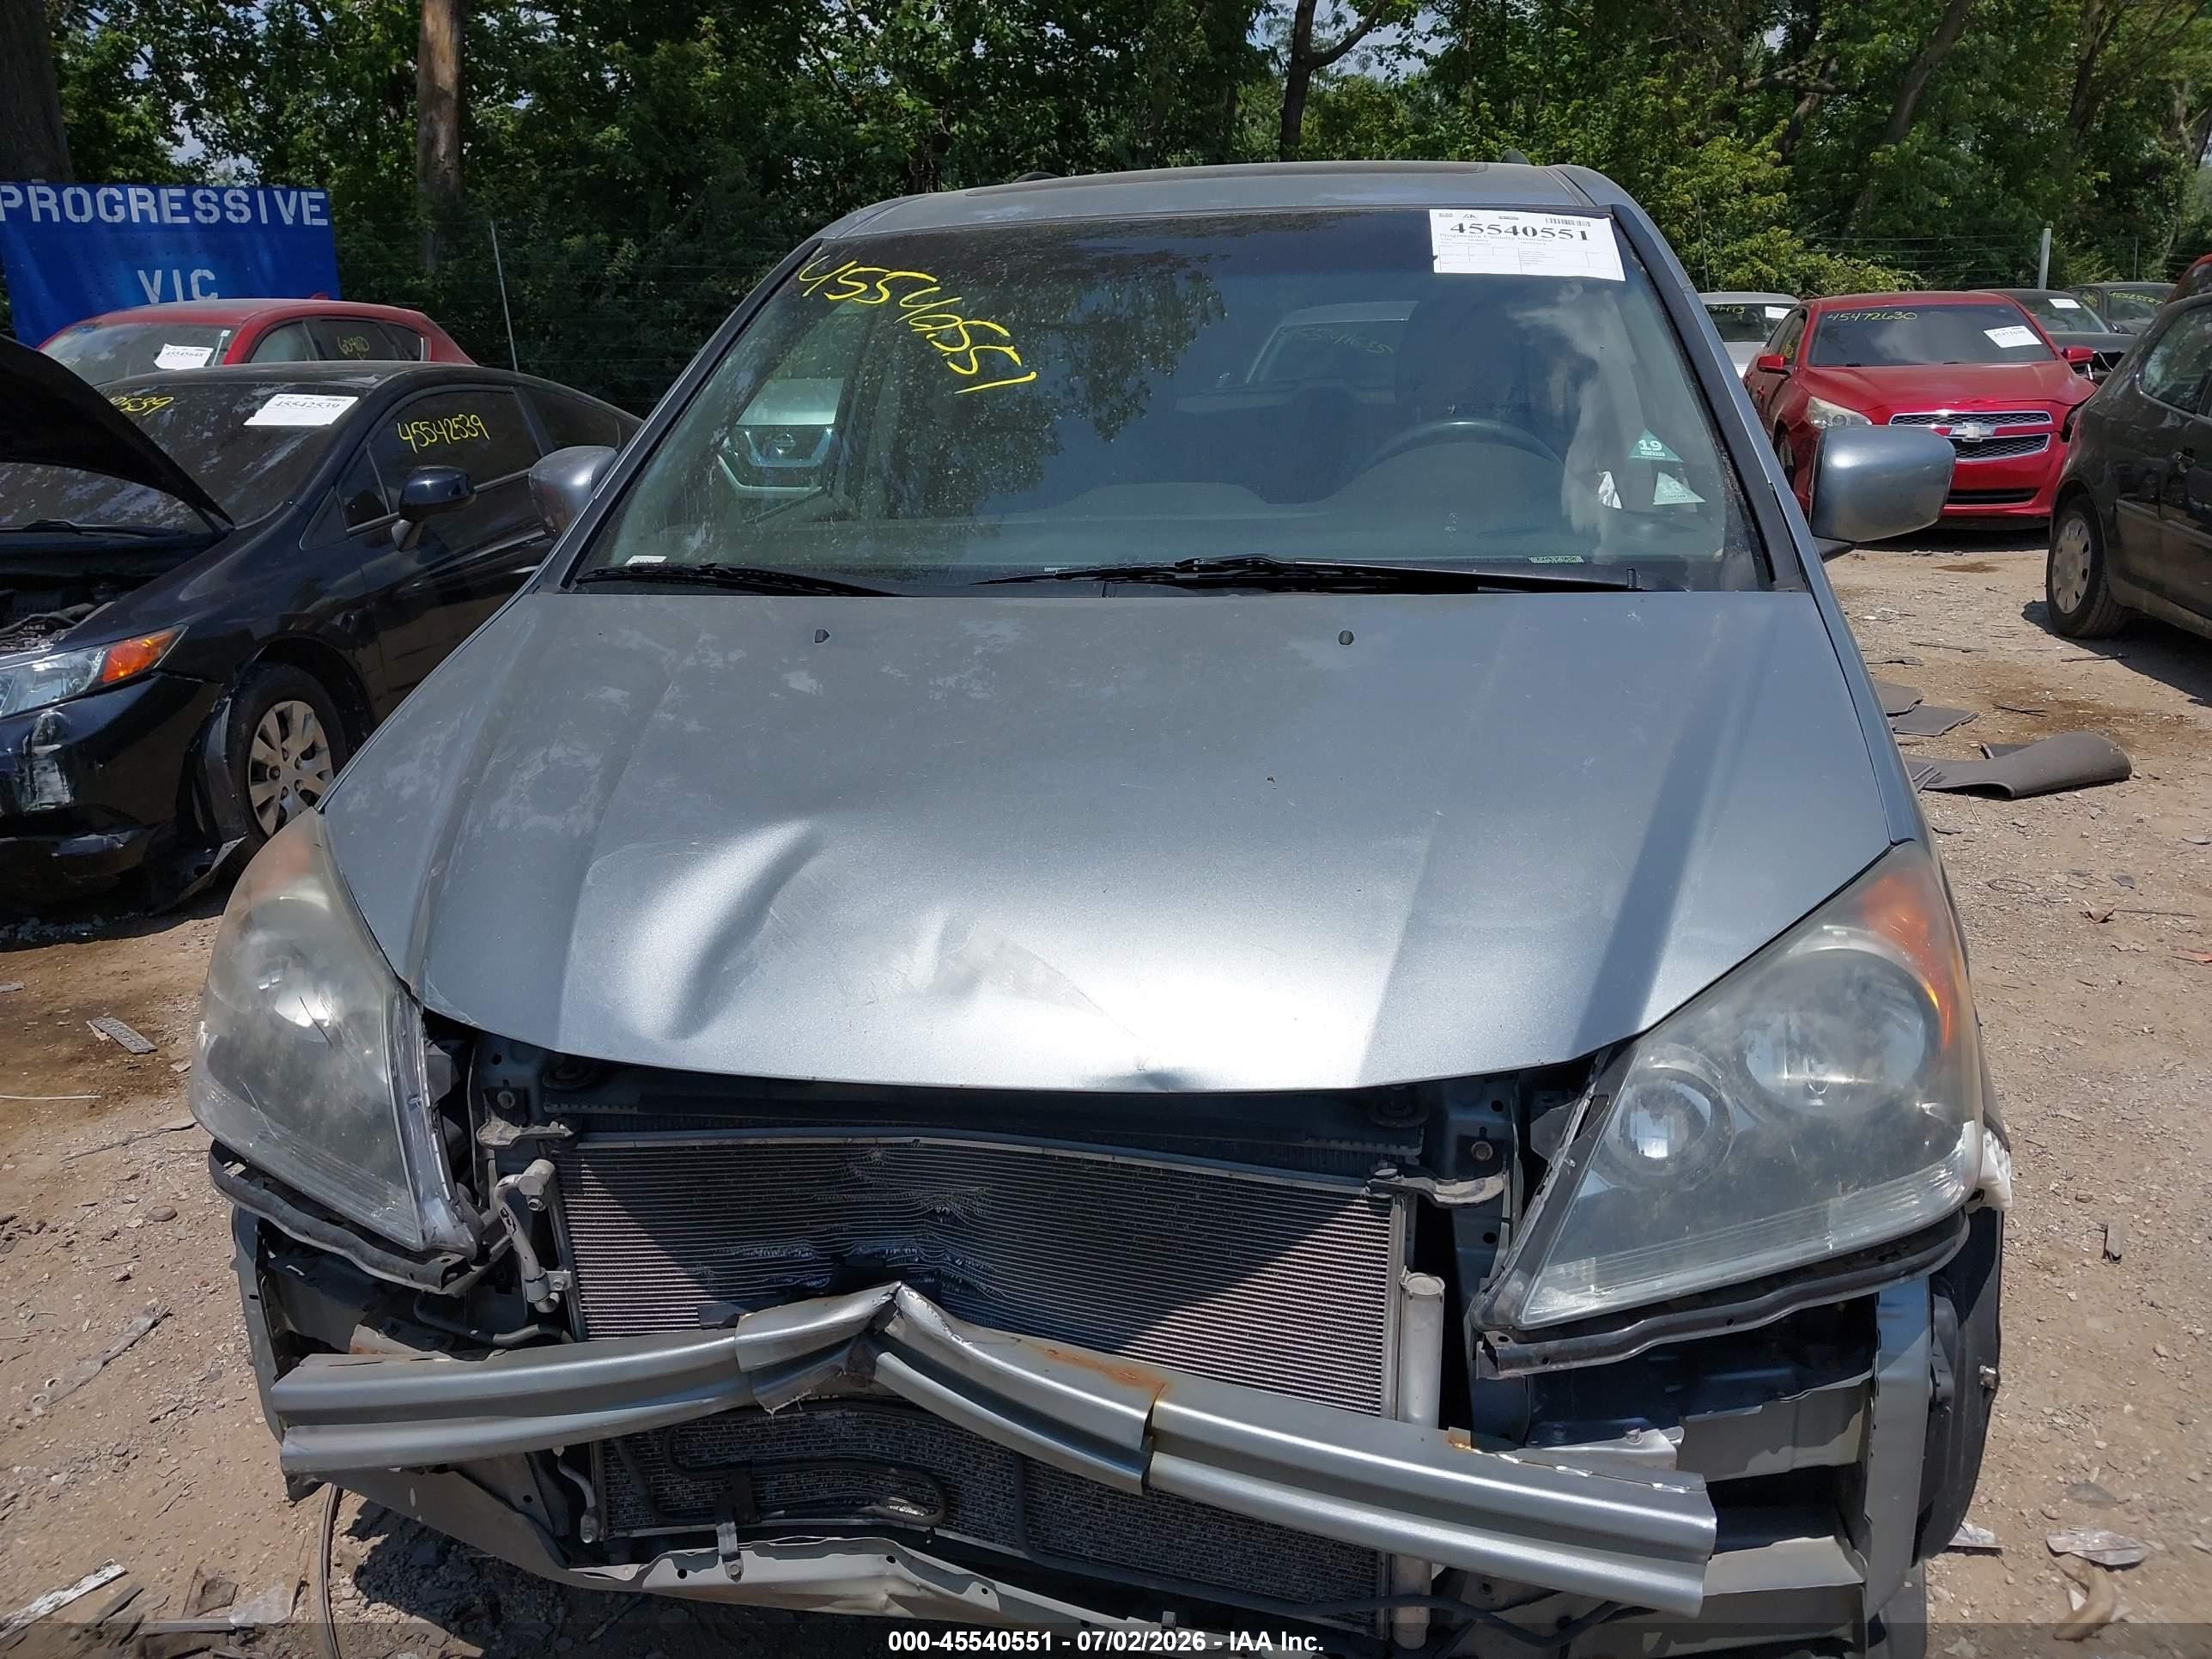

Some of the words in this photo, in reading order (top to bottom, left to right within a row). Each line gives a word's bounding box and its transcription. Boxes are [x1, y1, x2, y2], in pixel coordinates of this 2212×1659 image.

[0, 185, 329, 226] PROGRESSIVE
[1449, 222, 1591, 241] 45540551
[137, 269, 219, 303] VIC
[798, 254, 1038, 395] 45540551
[1826, 311, 1917, 321] 45472630
[397, 414, 490, 454] 45542539
[1638, 439, 1662, 451] 19
